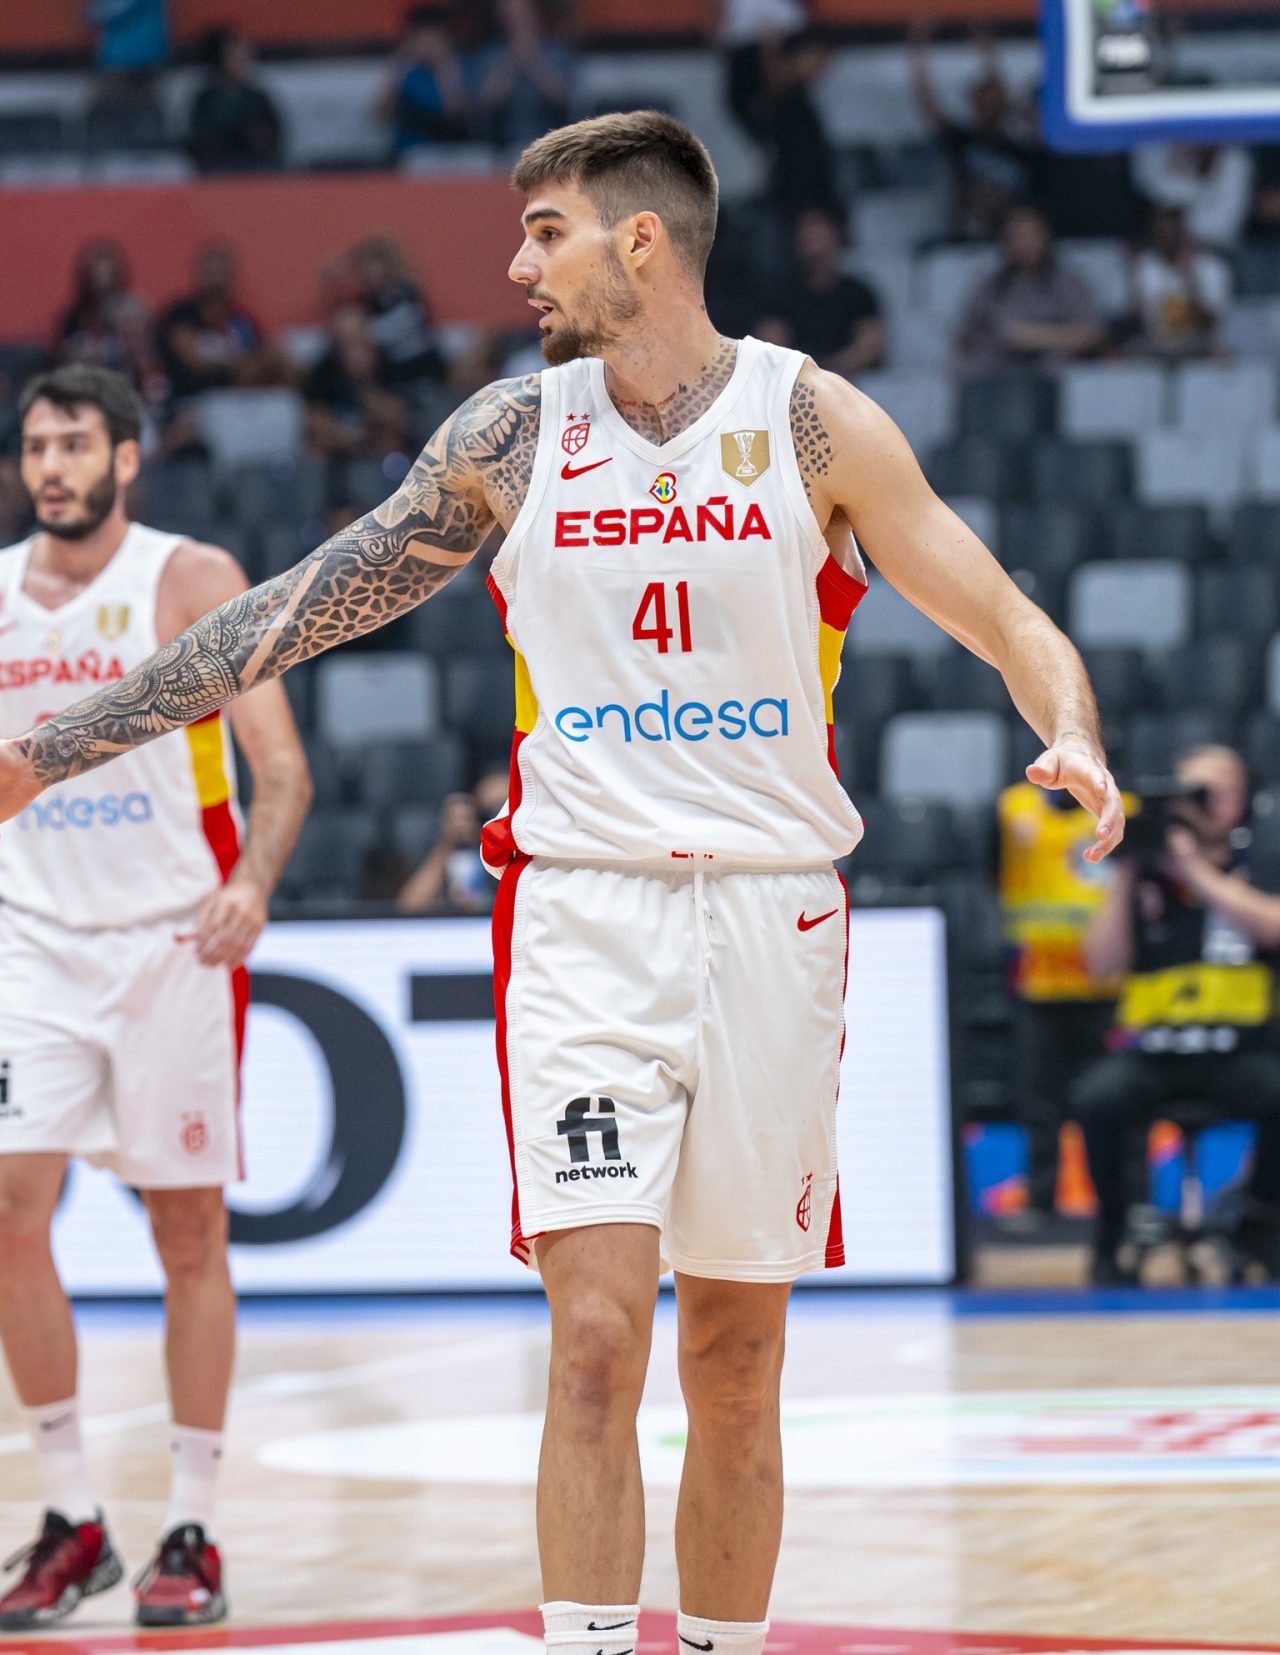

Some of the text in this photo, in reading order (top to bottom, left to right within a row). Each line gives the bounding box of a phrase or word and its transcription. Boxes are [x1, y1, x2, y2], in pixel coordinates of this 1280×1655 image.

[554, 495, 772, 548] ESPAÑA
[632, 581, 692, 654] 41
[555, 689, 789, 742] endesa
[17, 790, 153, 832] ndesa
[556, 1097, 622, 1164] fi
[555, 1161, 639, 1184] network
